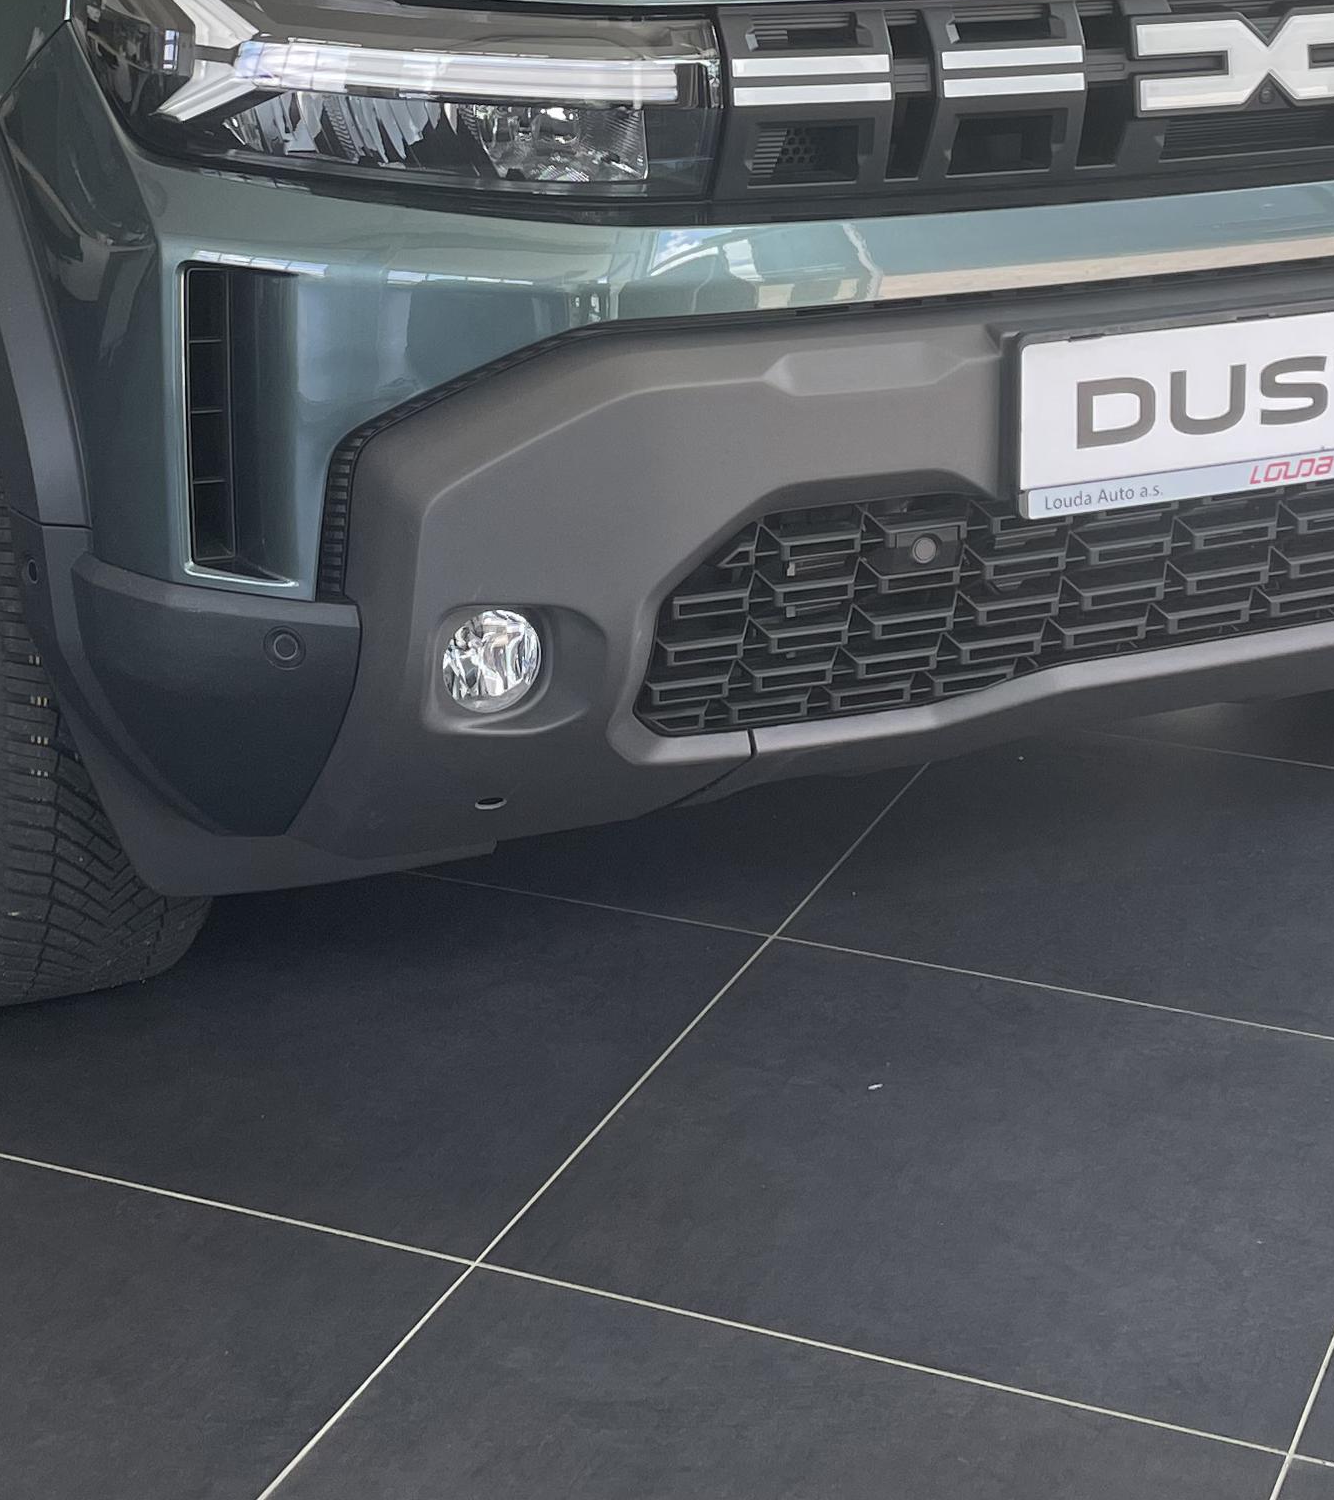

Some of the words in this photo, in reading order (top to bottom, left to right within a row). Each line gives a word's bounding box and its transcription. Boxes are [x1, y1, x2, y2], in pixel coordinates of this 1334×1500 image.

[1045, 491, 1093, 510] Louda
[1098, 488, 1135, 503] Auto
[1140, 485, 1163, 497] a.s.
